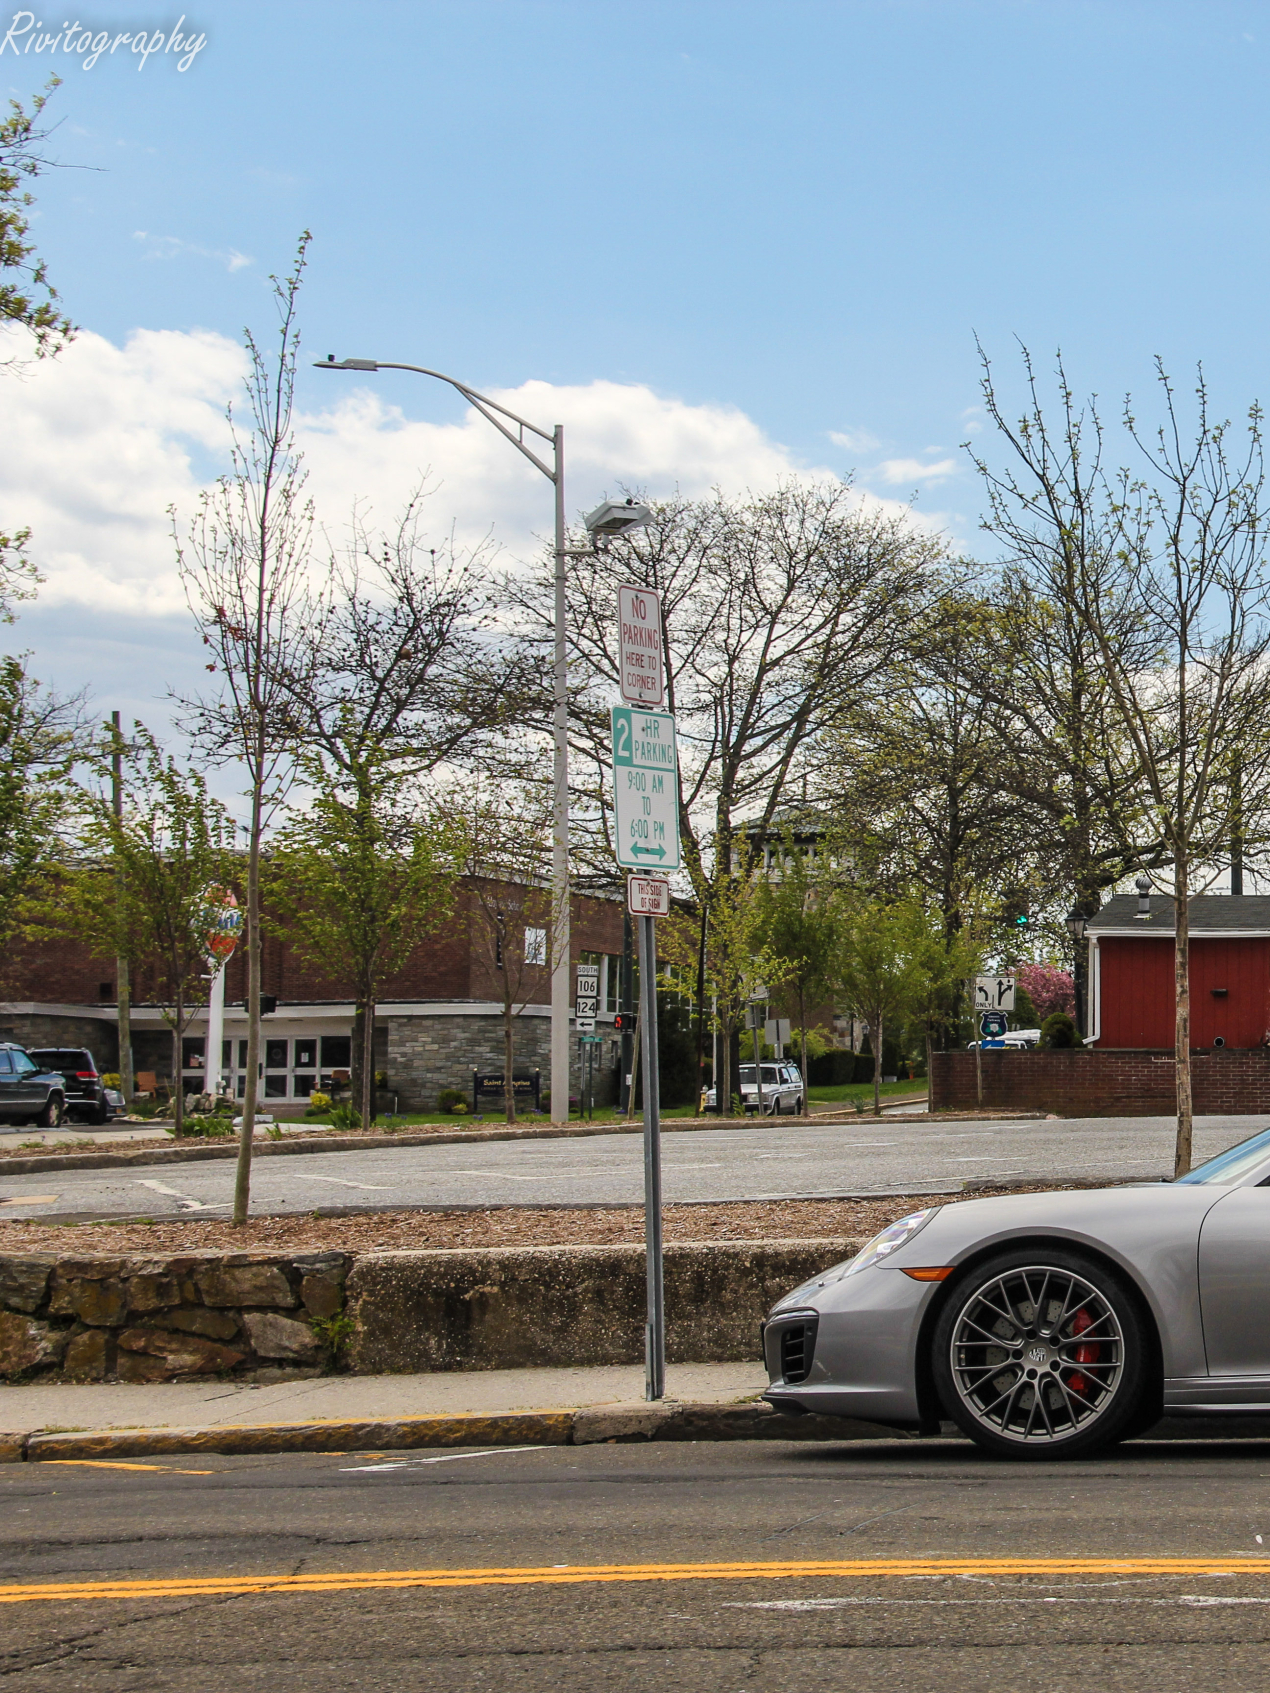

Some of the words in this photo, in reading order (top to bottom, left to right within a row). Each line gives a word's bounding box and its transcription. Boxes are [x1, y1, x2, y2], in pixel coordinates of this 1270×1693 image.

[632, 597, 647, 620] NO
[623, 622, 658, 651] PARKING
[625, 651, 645, 668] HERE
[648, 655, 657, 671] TO
[627, 672, 656, 691] CORNER
[616, 718, 630, 758] 2
[645, 719, 660, 739] HR
[634, 740, 672, 764] PARKING
[628, 771, 646, 792] 9:00
[652, 774, 664, 794] AM
[642, 796, 651, 816] TO
[630, 819, 648, 839] 6:00
[653, 821, 665, 841] PM
[638, 883, 649, 895] THIS
[650, 884, 662, 896] SIDE
[641, 896, 647, 908] OF
[648, 897, 660, 909] SIGN
[579, 980, 595, 992] 106
[577, 1001, 595, 1014] 124
